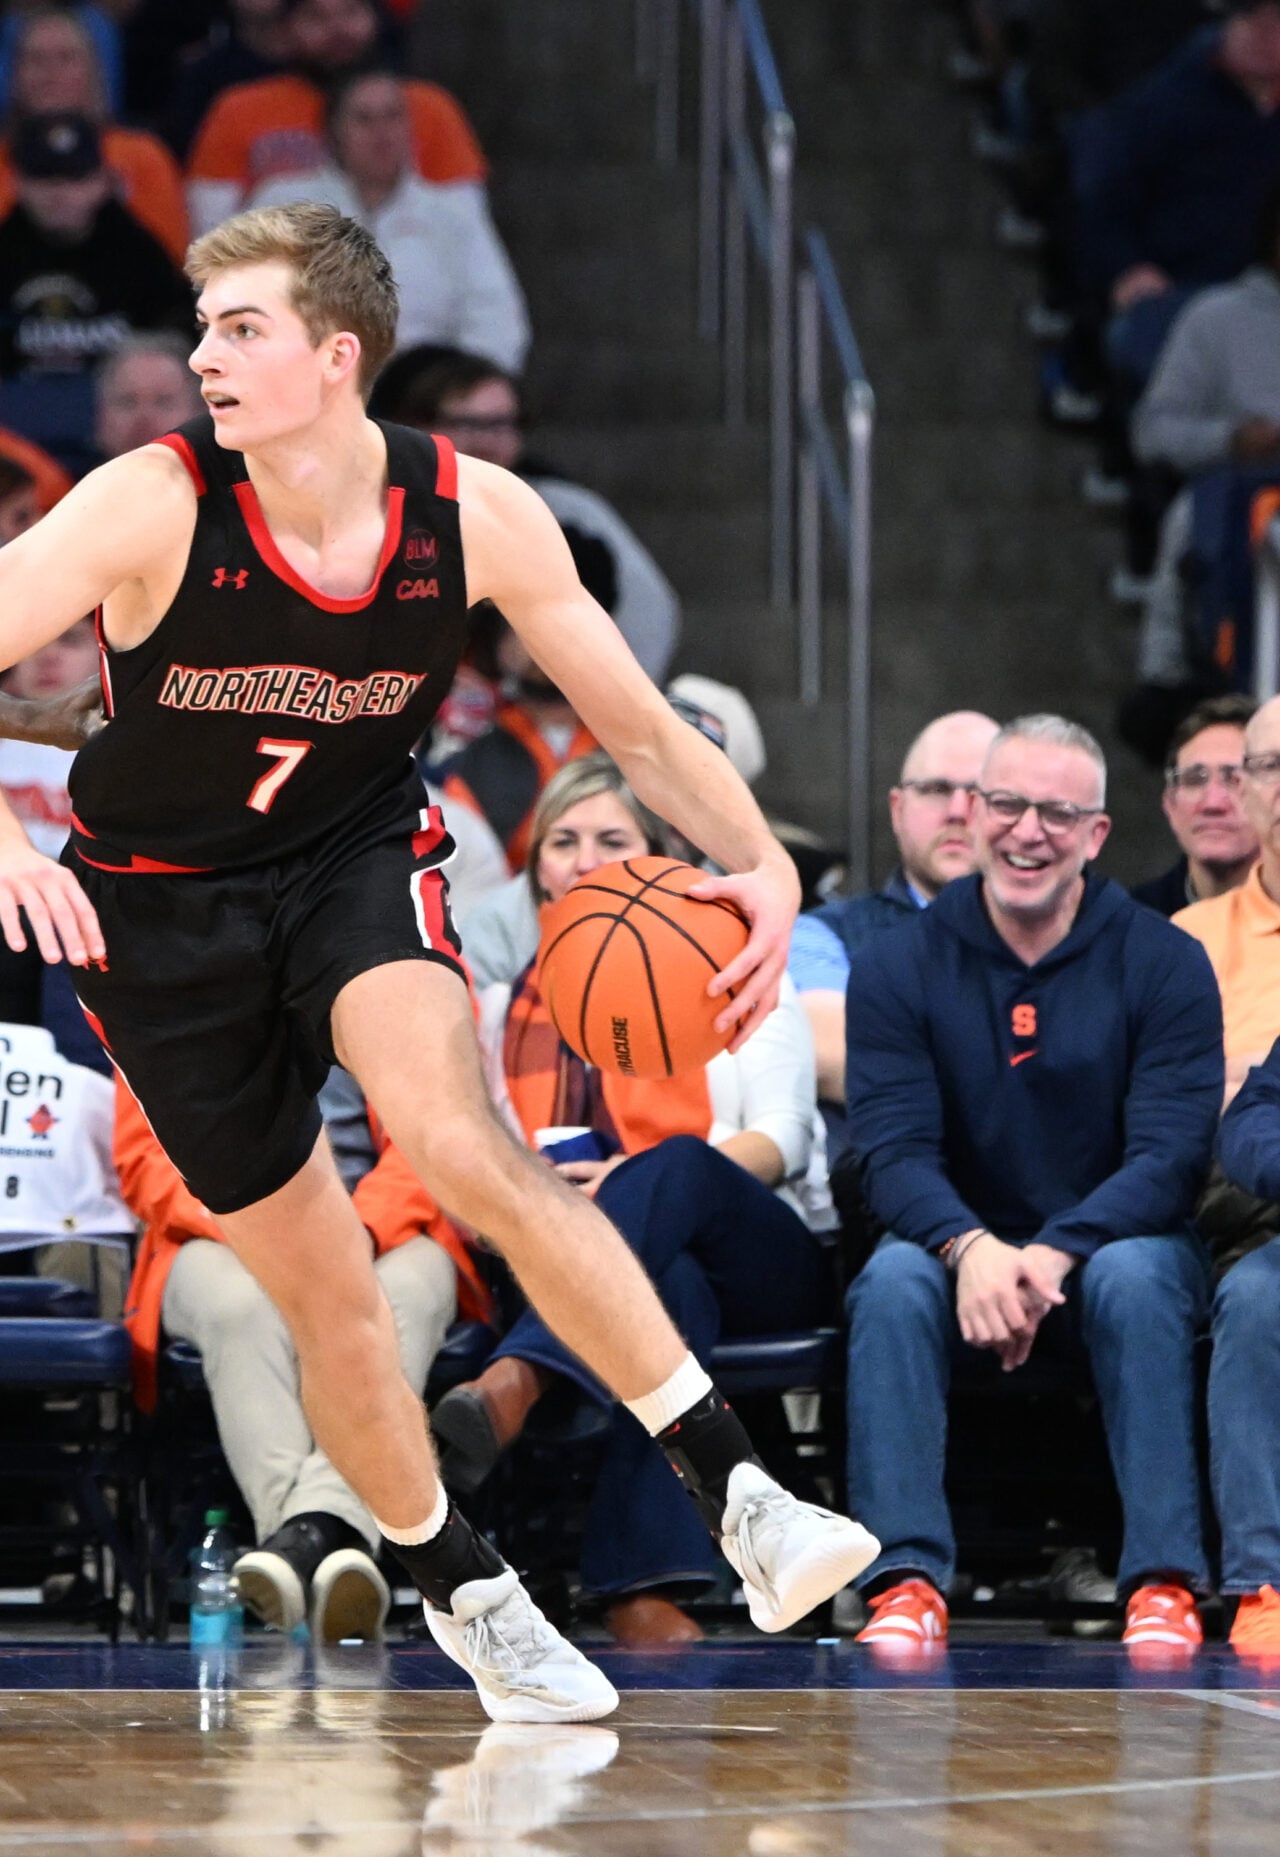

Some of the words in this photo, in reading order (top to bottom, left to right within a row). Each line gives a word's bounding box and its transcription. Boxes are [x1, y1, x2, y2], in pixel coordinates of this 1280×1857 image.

[406, 537, 437, 560] BLM
[396, 578, 439, 600] CAA
[158, 663, 428, 724] NORTHEASERN
[246, 737, 313, 815] 7
[1012, 1004, 1036, 1036] S
[6, 1175, 19, 1199] 8
